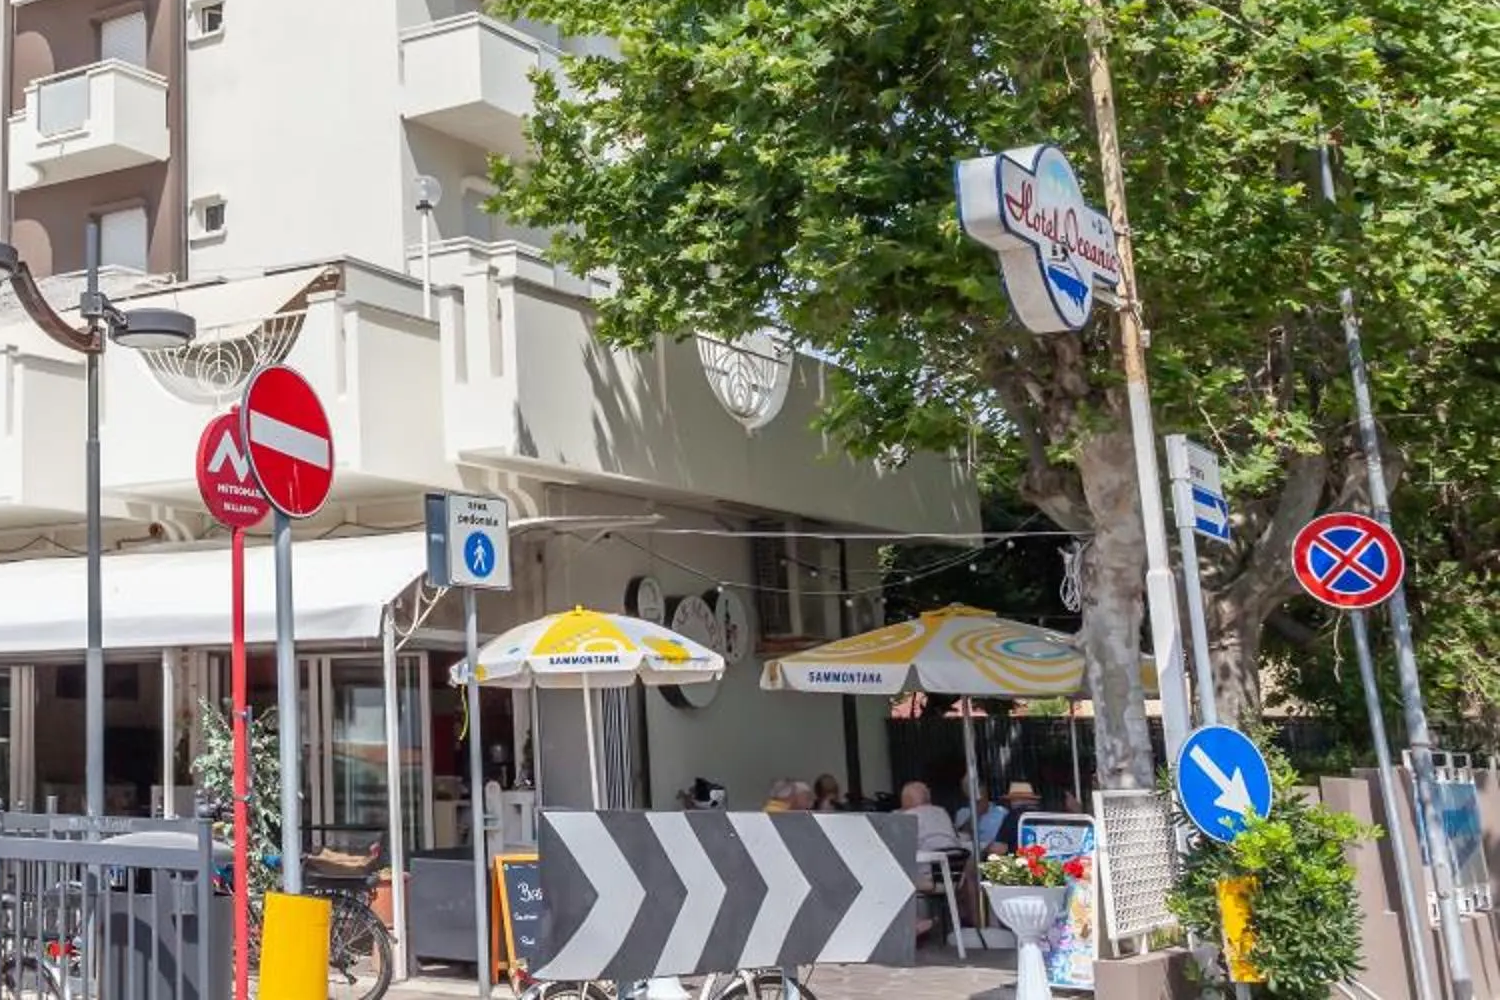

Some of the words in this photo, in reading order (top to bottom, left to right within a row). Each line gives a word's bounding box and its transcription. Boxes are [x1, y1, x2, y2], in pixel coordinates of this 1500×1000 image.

[1004, 180, 1063, 243] Hotel
[549, 655, 621, 665] SAMMONTANA
[809, 671, 882, 684] SAMMONTANA
